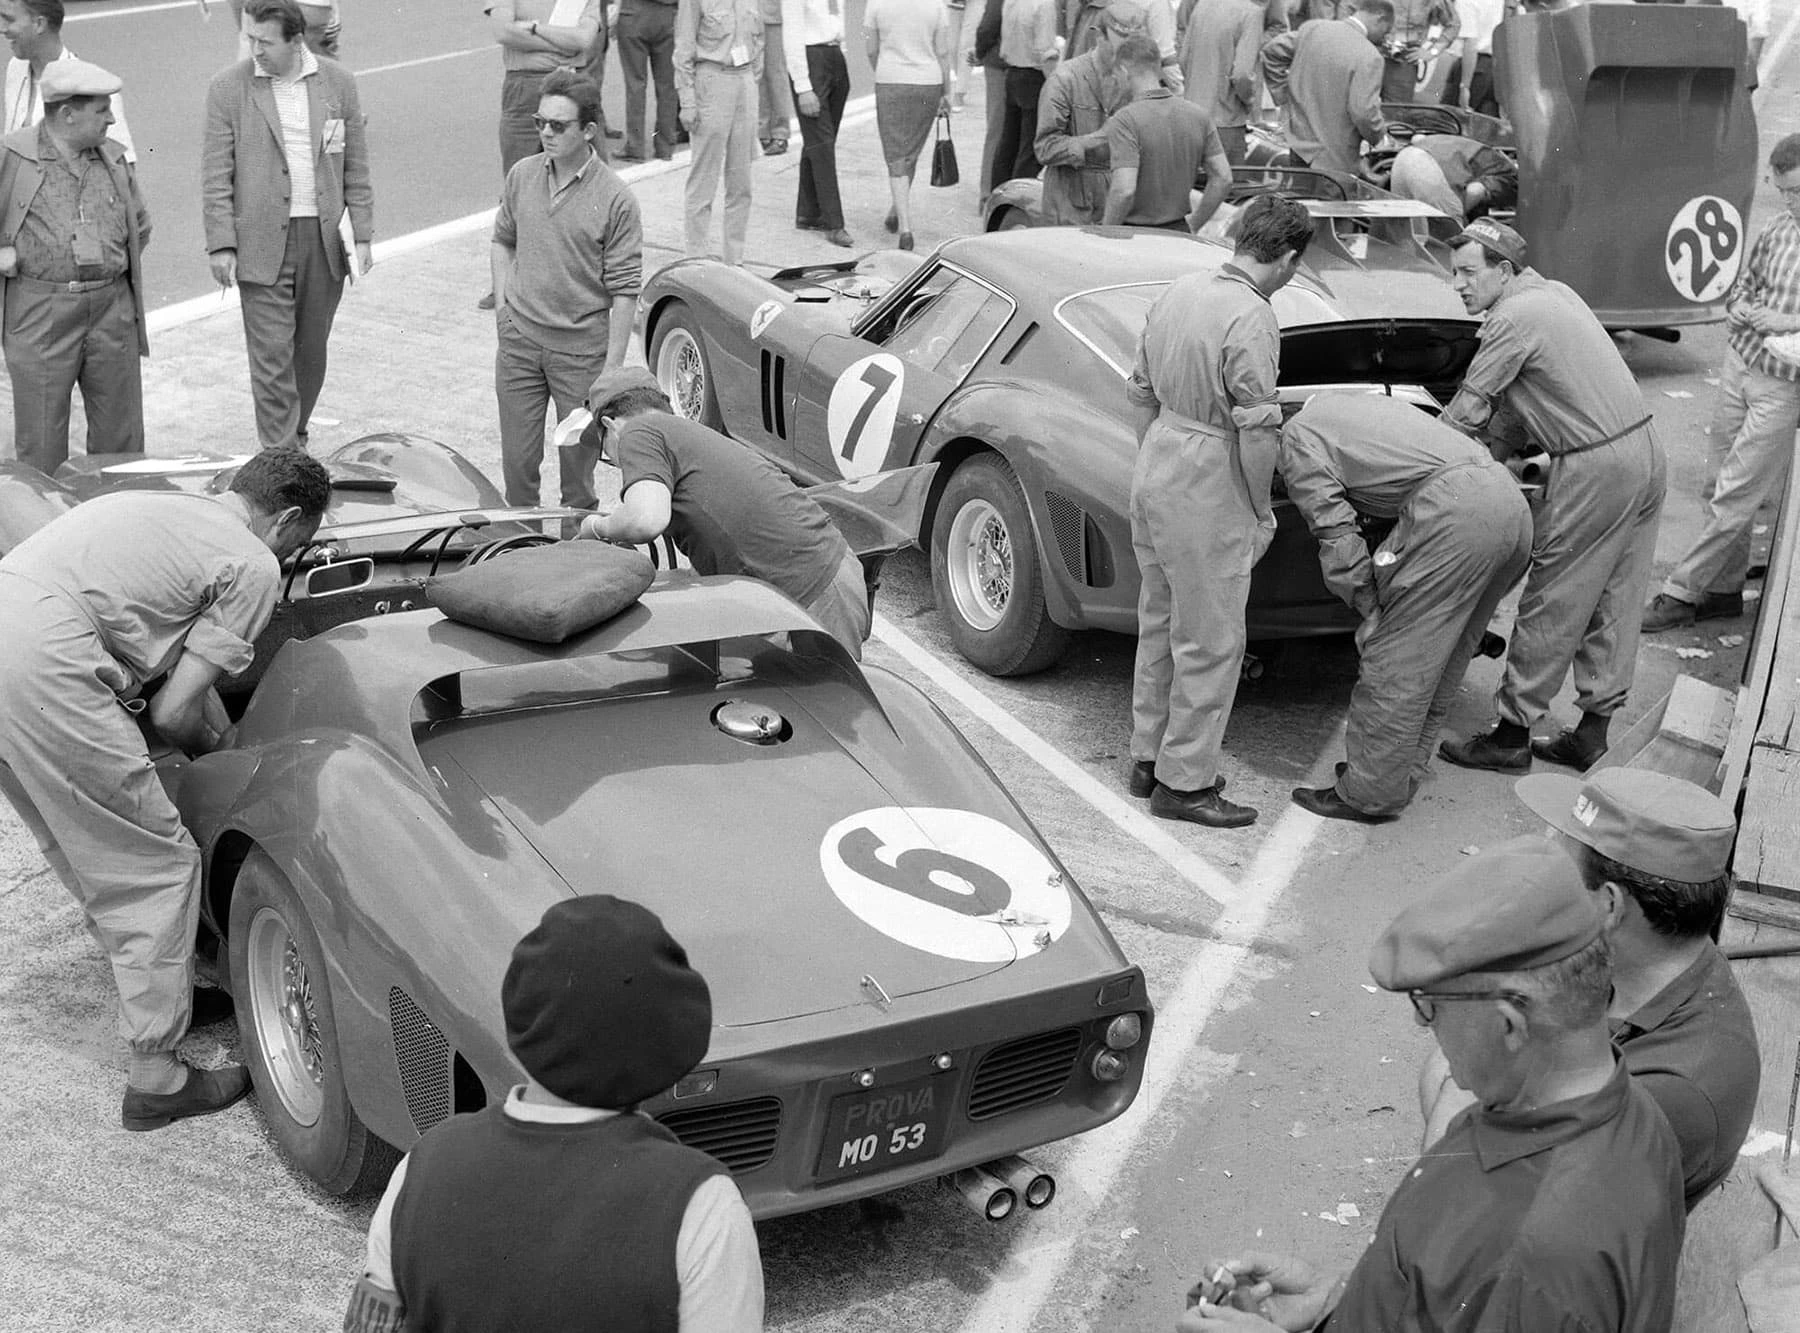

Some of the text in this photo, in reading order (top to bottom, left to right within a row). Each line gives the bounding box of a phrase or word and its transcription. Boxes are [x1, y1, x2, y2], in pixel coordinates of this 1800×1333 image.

[1668, 198, 1738, 298] 28
[840, 361, 897, 463] 7
[837, 826, 1012, 917] 6
[838, 1122, 927, 1168] MO 53
[844, 1085, 934, 1132] PROVA
